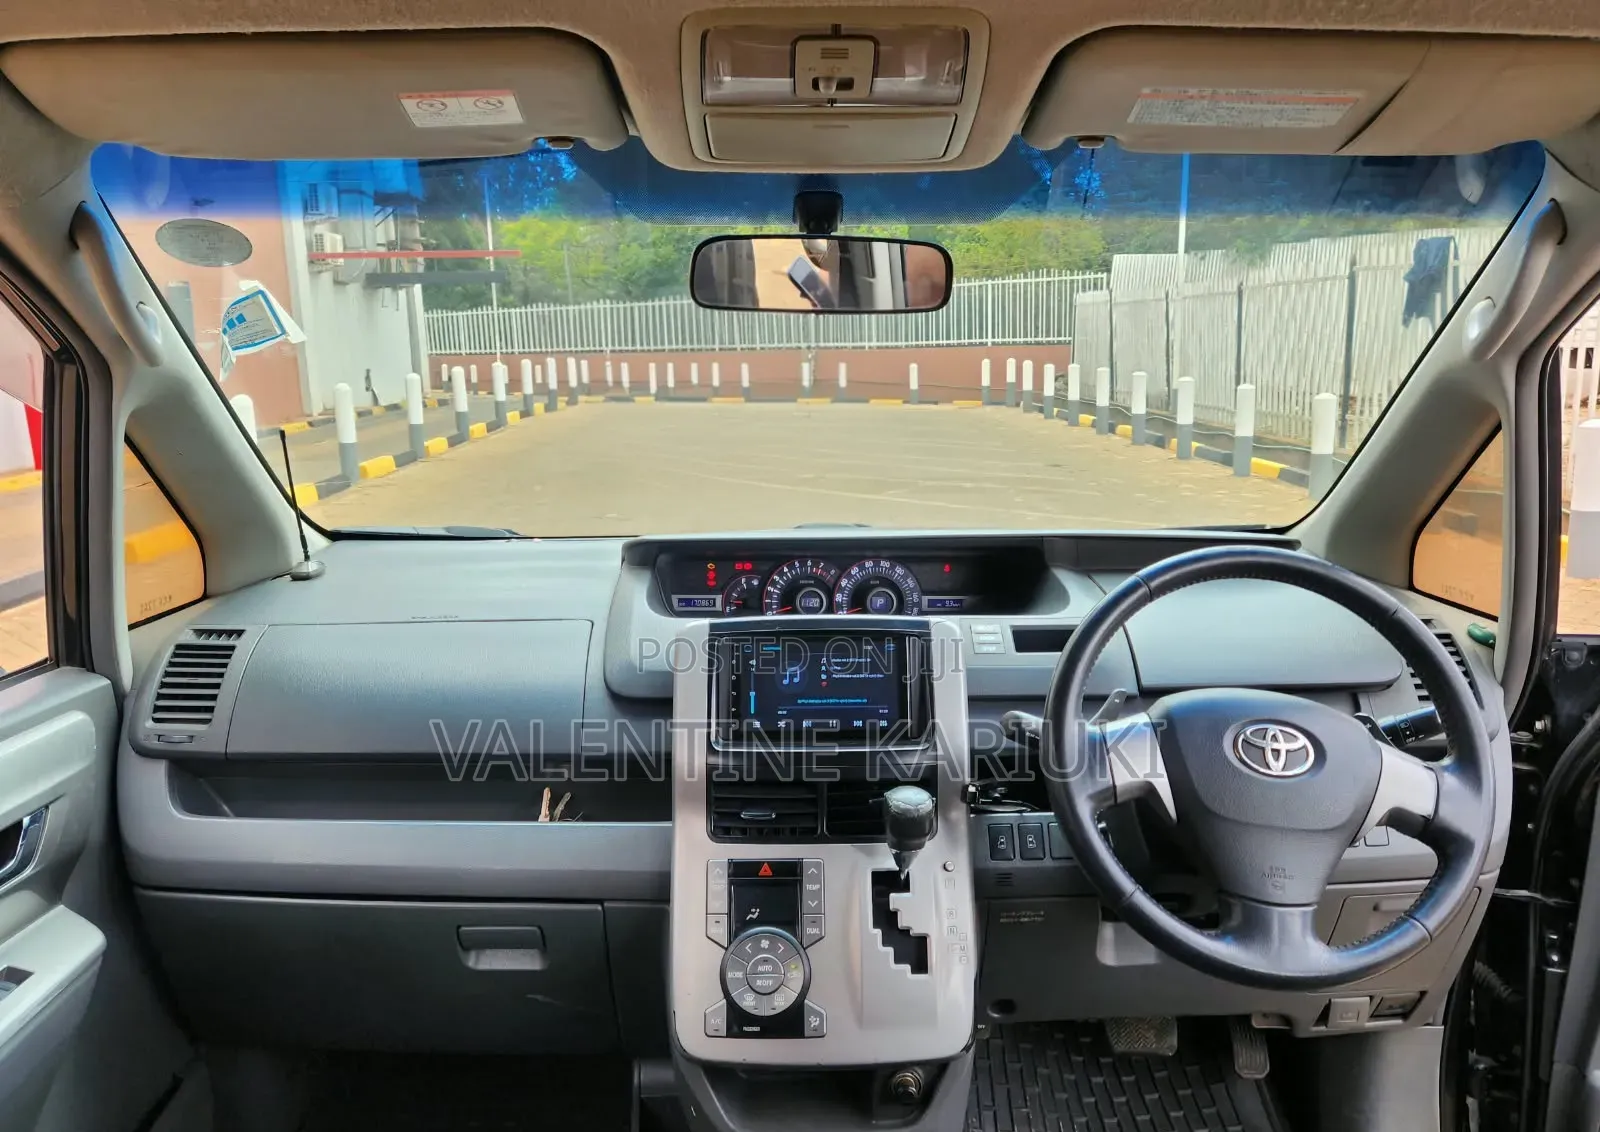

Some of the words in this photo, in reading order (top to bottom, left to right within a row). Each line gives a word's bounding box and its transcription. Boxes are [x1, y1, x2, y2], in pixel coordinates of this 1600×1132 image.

[850, 566, 859, 575] 60
[894, 566, 904, 576] 120
[840, 578, 848, 588] 40
[906, 577, 914, 588] 140
[836, 594, 842, 602] 20
[876, 598, 884, 608] P
